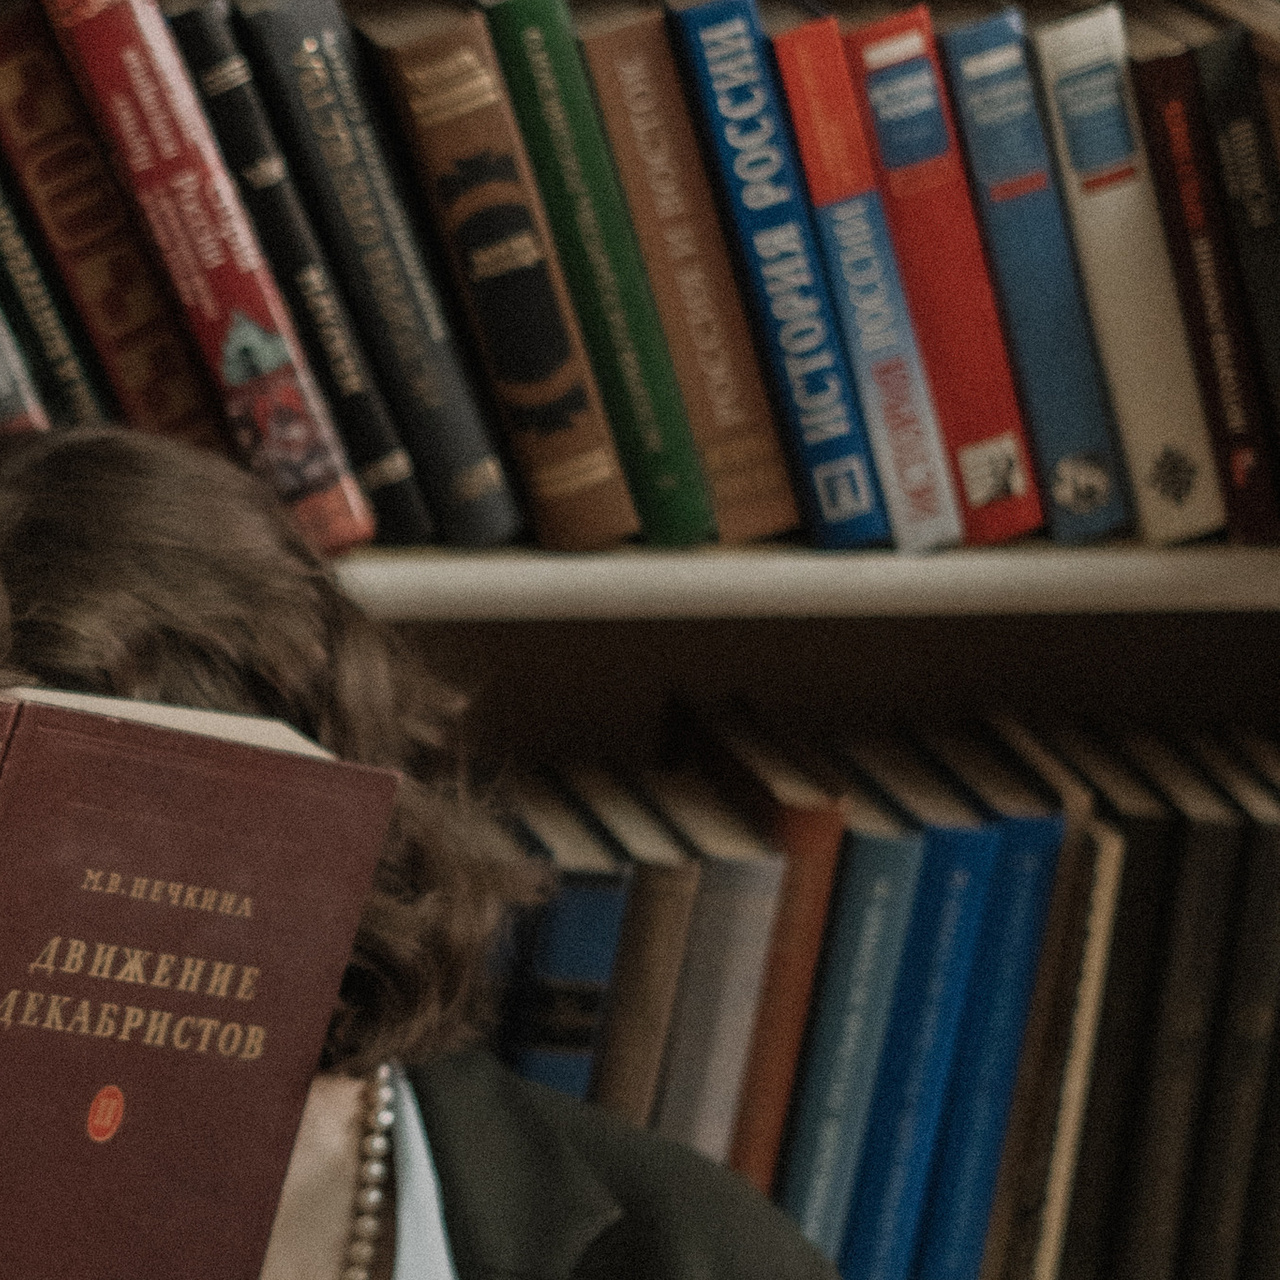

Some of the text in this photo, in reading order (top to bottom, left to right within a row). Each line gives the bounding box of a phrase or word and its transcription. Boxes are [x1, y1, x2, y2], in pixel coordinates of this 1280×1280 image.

[700, 15, 849, 446] ИСТОРИЯ РОССИИ
[834, 199, 898, 355] РОССИИ
[872, 358, 940, 522] ИСТОРИЯ
[29, 934, 262, 1002] ДВИЖЕНИЕ
